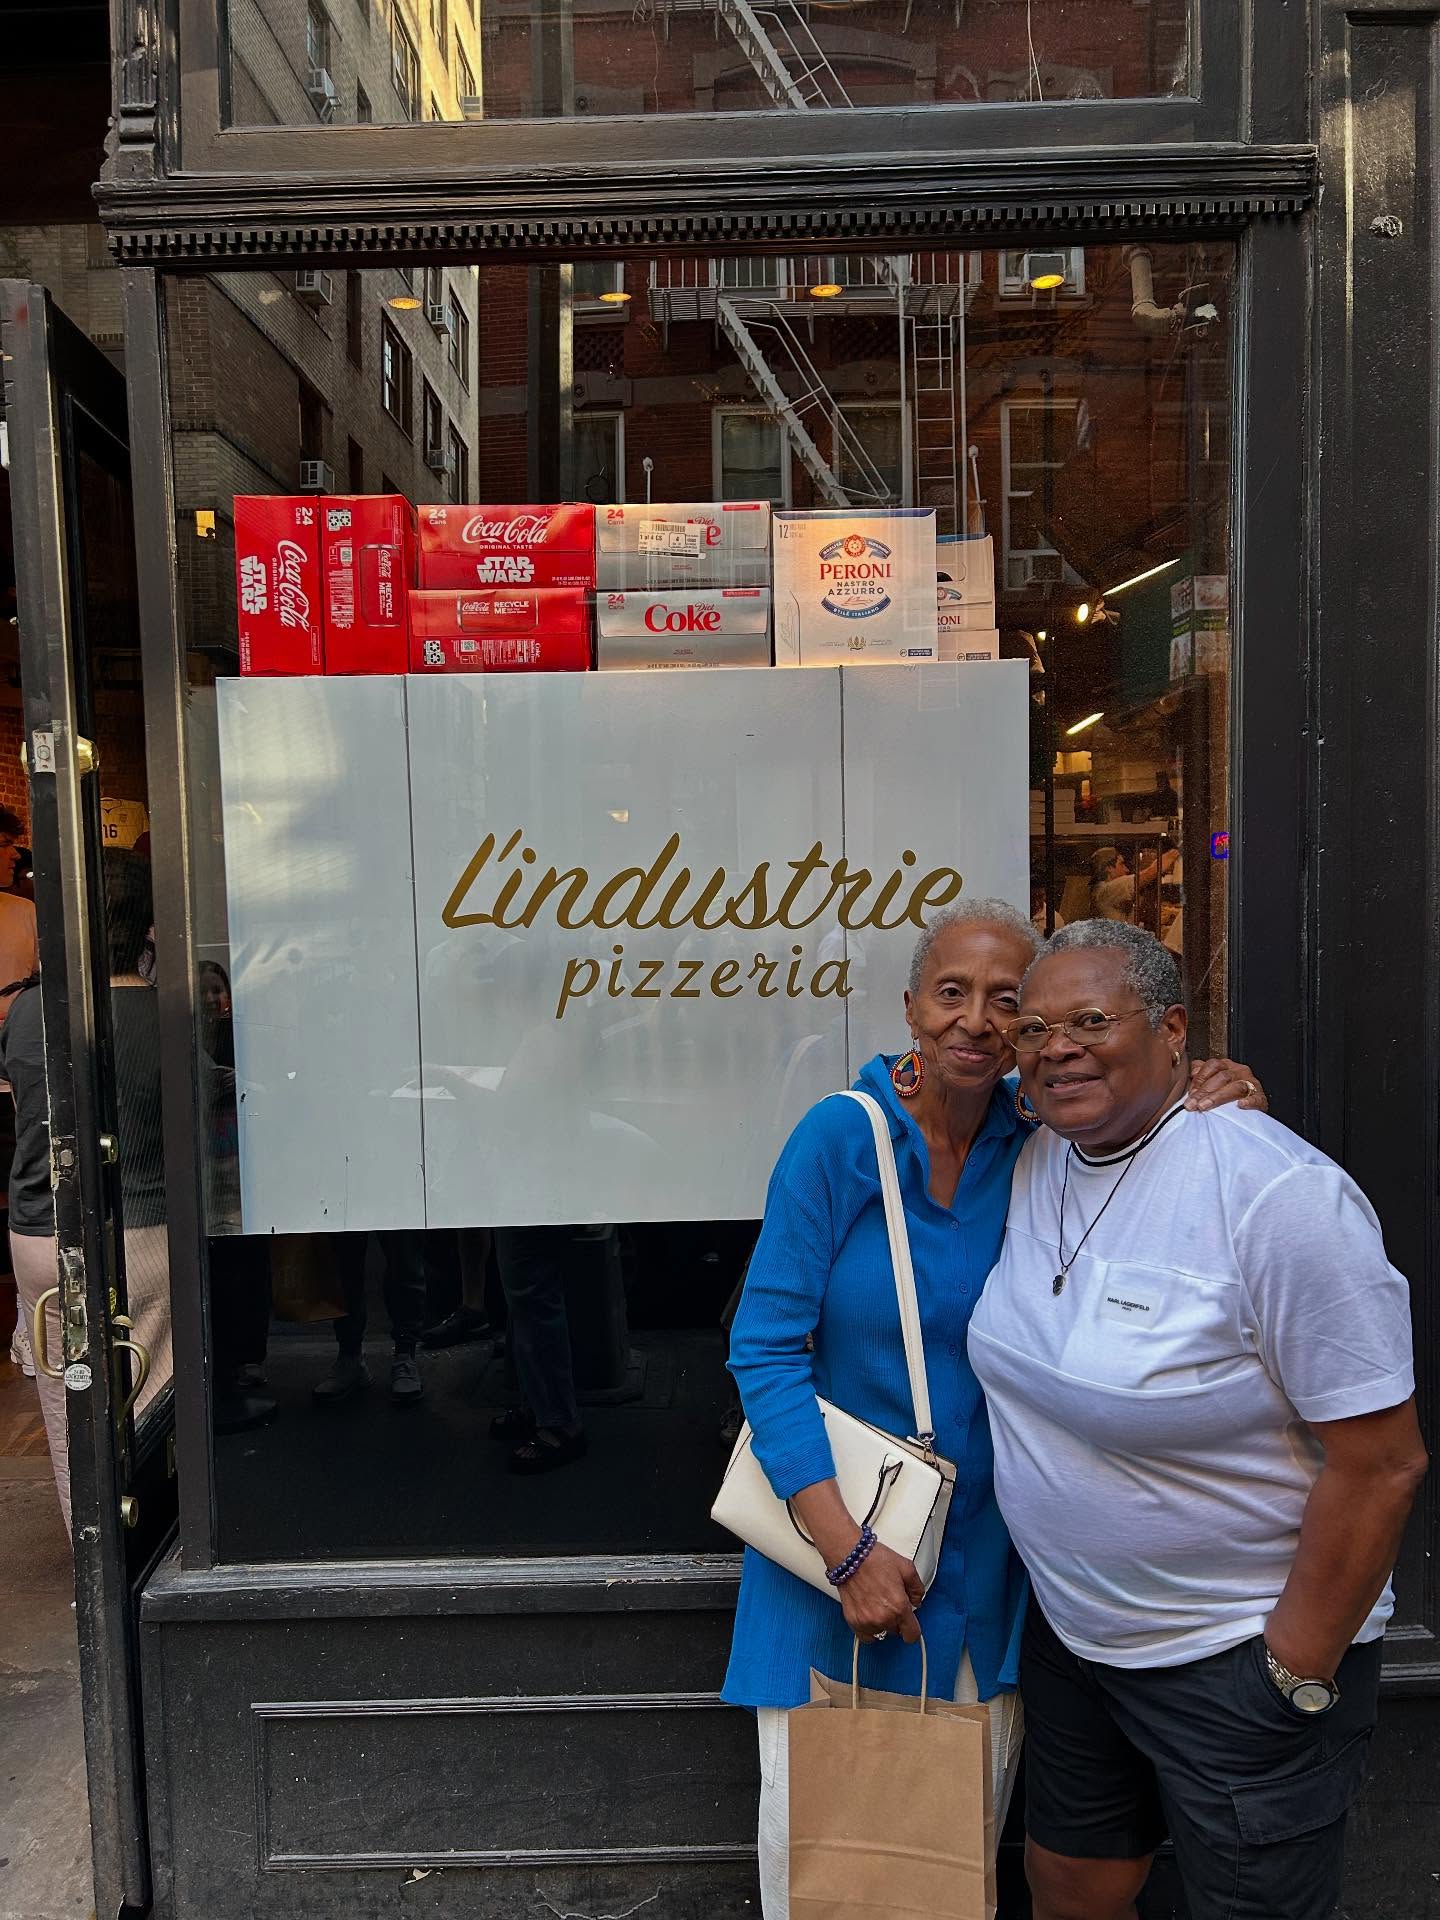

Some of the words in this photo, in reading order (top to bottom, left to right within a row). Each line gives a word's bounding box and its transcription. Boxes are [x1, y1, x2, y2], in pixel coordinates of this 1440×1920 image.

[301, 506, 314, 526] 24
[429, 509, 447, 519] 24
[607, 509, 625, 519] 24
[694, 516, 715, 526] Diet
[461, 514, 554, 544] Coca-Cola
[779, 524, 789, 539] 12
[476, 556, 535, 570] STAR
[476, 569, 535, 583] WARS
[819, 563, 895, 580] PERONI
[239, 555, 255, 615] WARS
[252, 556, 268, 615] STAR
[277, 539, 310, 633] Coca-Cola
[378, 582, 386, 595] ME
[836, 580, 875, 588] NASTRO
[827, 587, 885, 596] AZZURRO
[385, 582, 393, 618] RECYCLE
[607, 594, 625, 604] 24
[694, 601, 715, 611] Diet
[644, 603, 722, 633] Coke
[937, 615, 961, 626] ONI
[441, 828, 963, 931] L'industrie
[556, 943, 855, 1020] pizzeria
